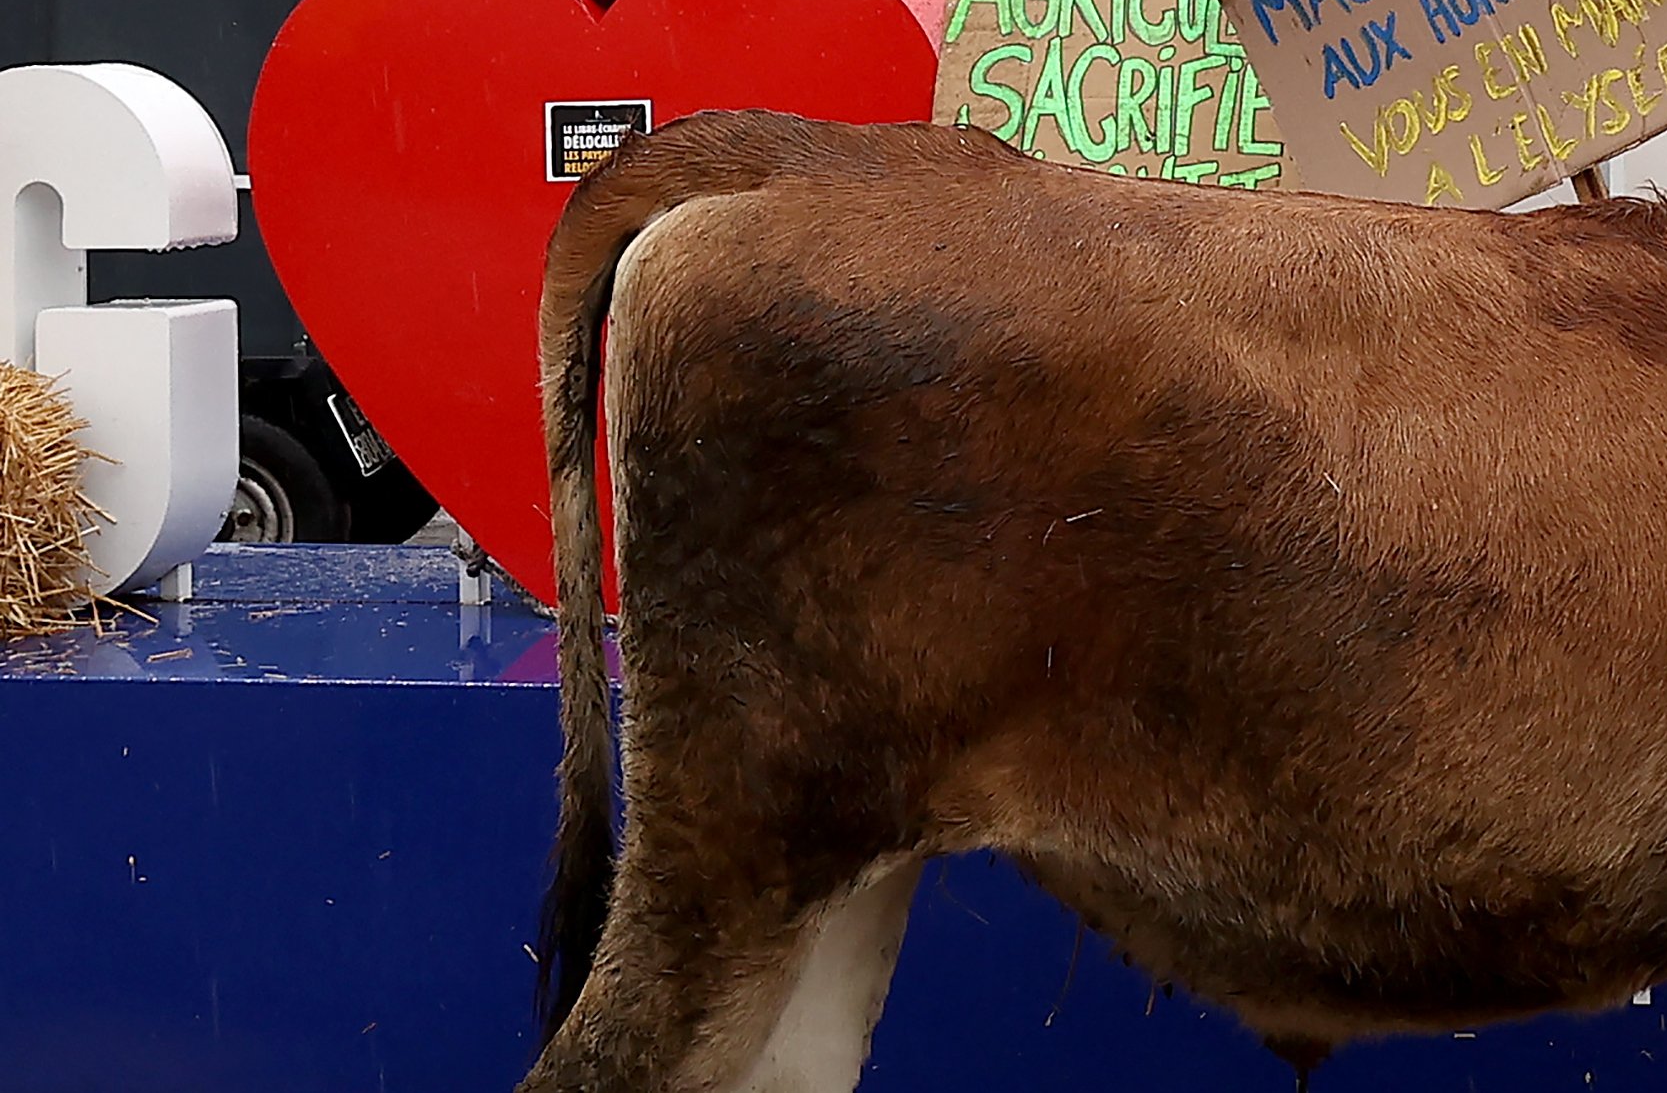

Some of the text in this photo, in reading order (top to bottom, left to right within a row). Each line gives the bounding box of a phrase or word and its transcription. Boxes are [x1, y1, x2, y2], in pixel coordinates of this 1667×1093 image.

[1322, 11, 1412, 99] AUX
[1339, 65, 1472, 178] VOUS
[1474, 23, 1547, 100] EN
[563, 134, 619, 149] DÉLOCALI
[1425, 162, 1463, 205] A
